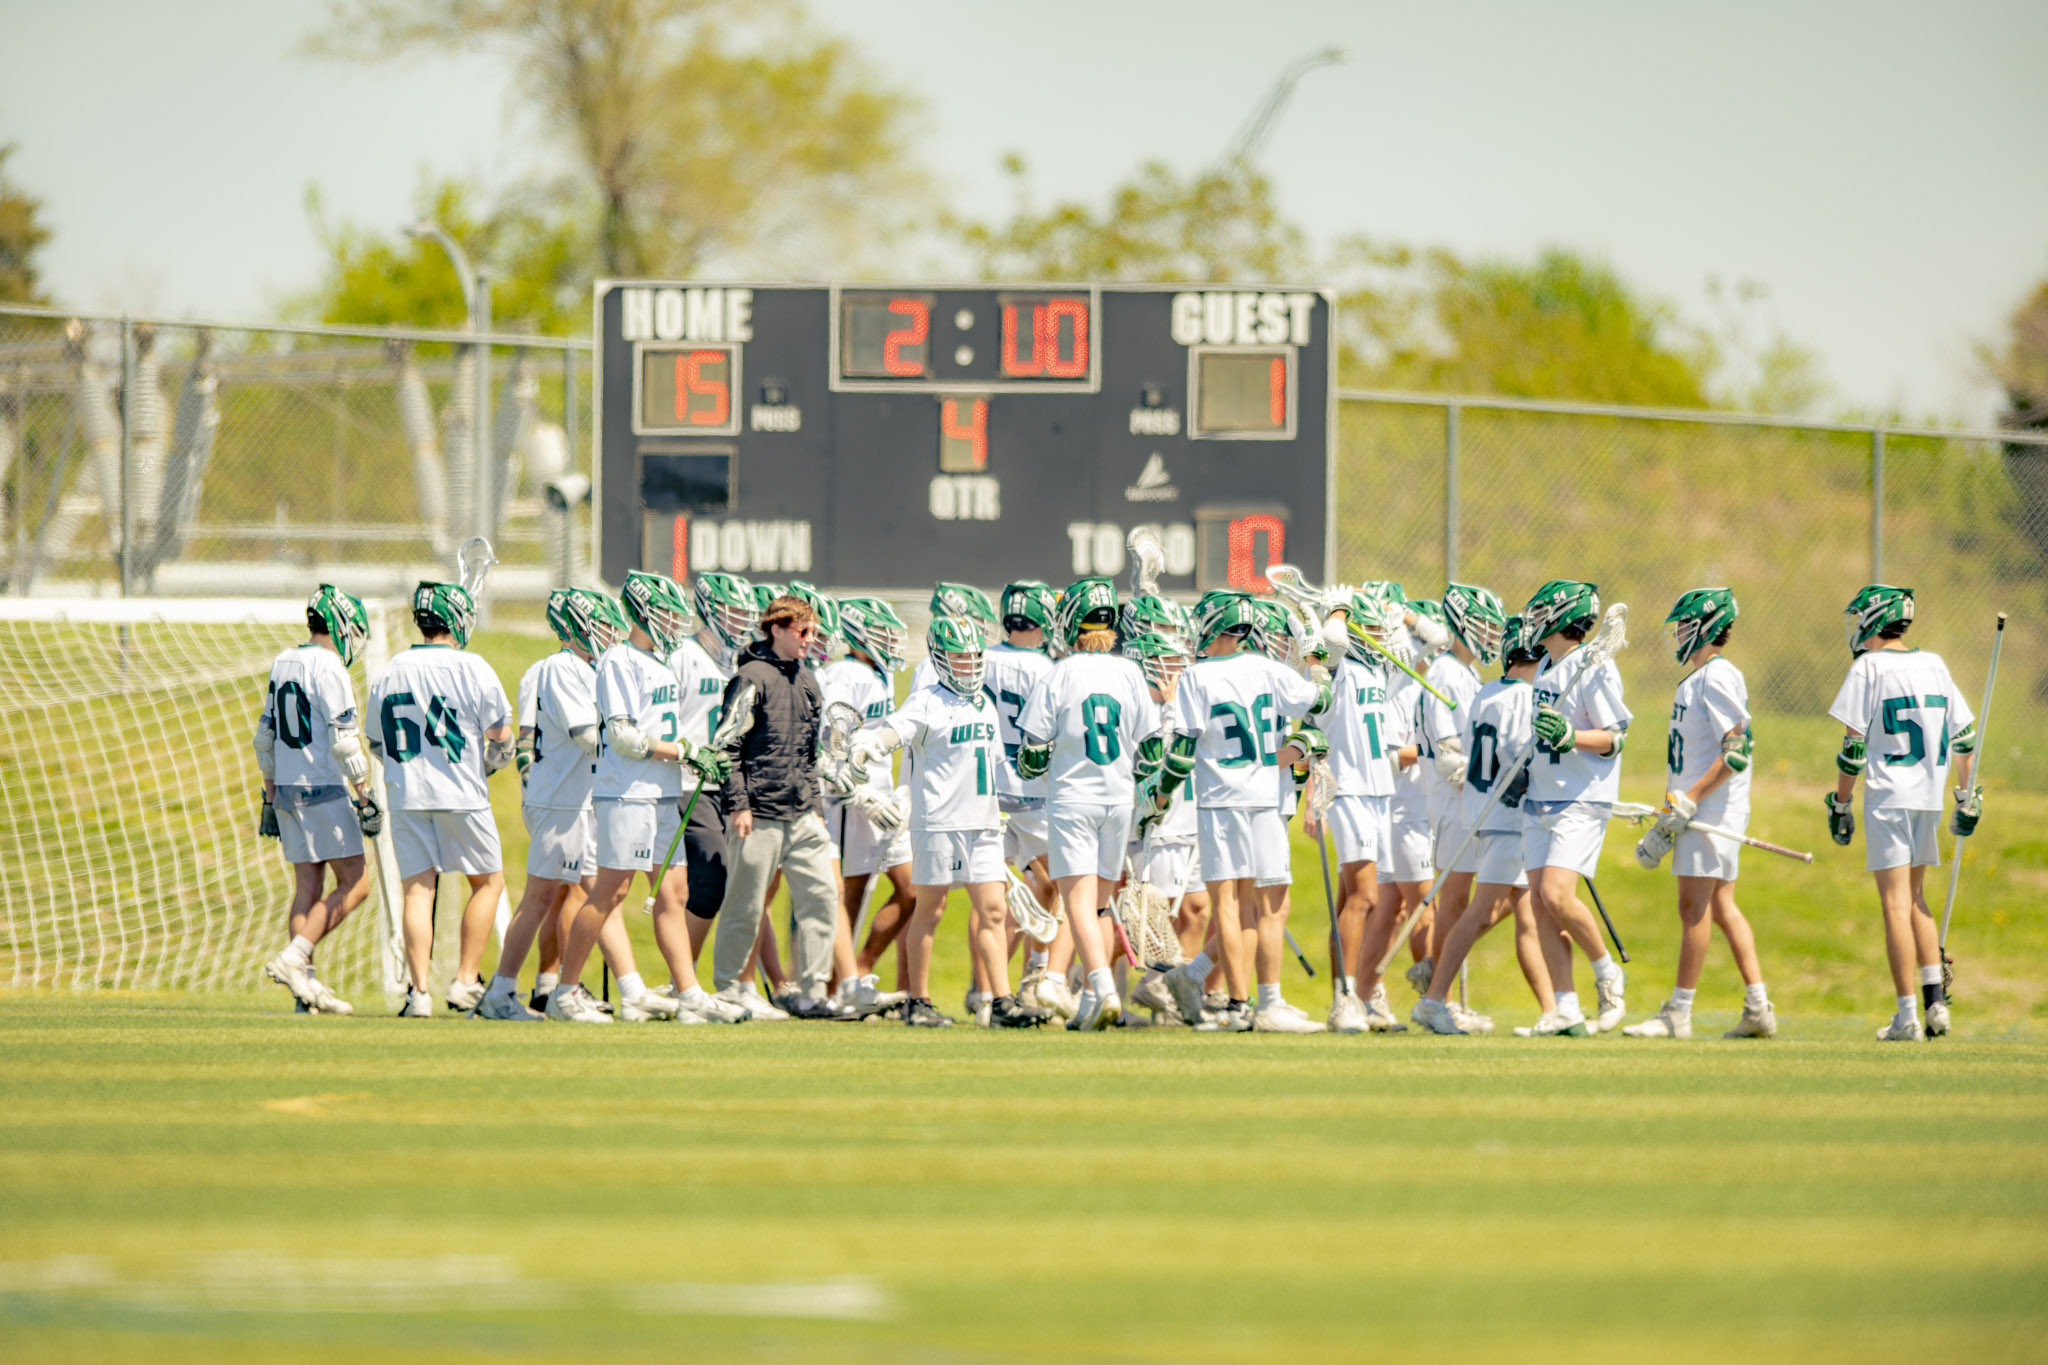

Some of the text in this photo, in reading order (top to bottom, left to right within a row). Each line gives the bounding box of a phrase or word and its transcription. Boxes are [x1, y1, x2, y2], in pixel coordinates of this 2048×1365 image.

[622, 288, 753, 341] HOME
[1171, 292, 1315, 346] GUEST
[675, 350, 729, 425] 15
[1269, 356, 1286, 426] 1
[942, 397, 988, 467] 4
[673, 513, 688, 583] 1
[691, 520, 812, 573] DOWN
[1067, 521, 1125, 576] TO
[335, 590, 357, 618] CATS
[449, 588, 468, 610] CATS
[571, 591, 596, 615] CATS
[628, 577, 652, 602] CATS
[1448, 588, 1470, 611] CATS
[1702, 599, 1716, 613] 40
[1124, 646, 1143, 661] CATS
[380, 691, 466, 764] 64
[1081, 693, 1122, 766] 8
[1882, 694, 1950, 768] 57
